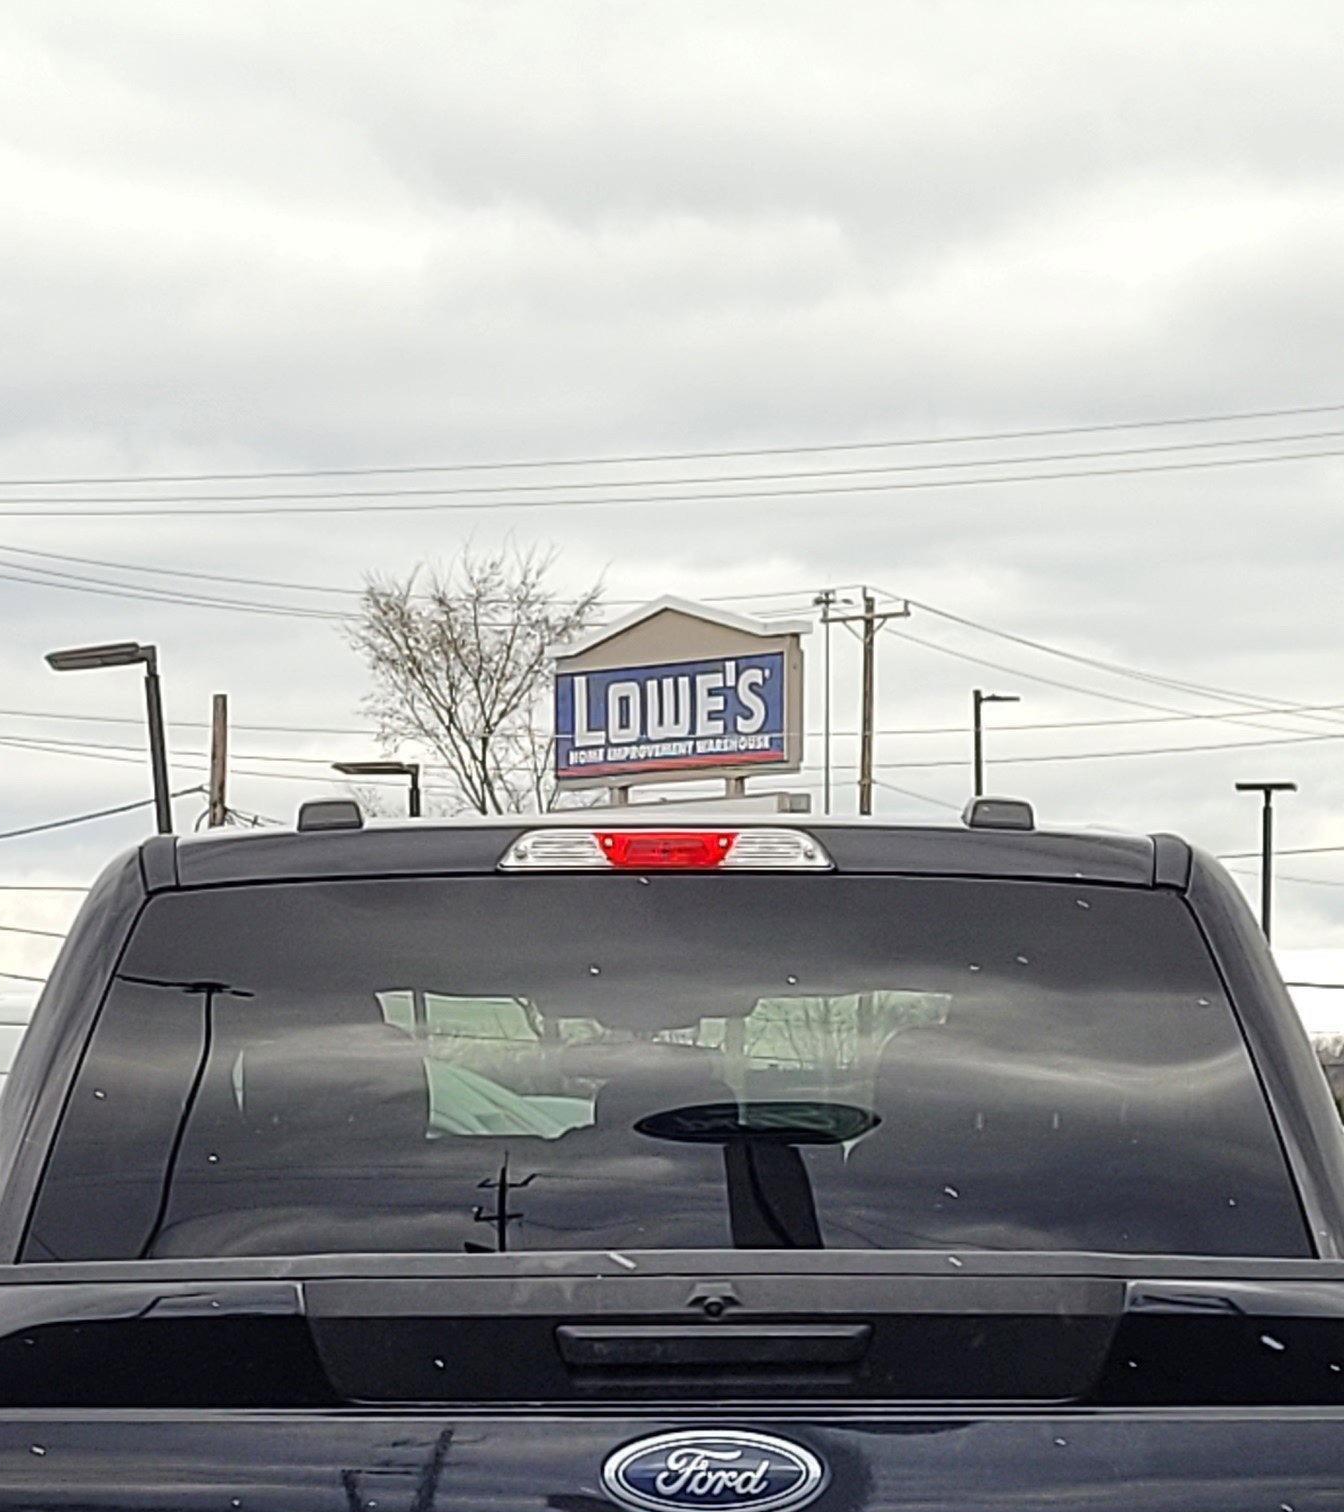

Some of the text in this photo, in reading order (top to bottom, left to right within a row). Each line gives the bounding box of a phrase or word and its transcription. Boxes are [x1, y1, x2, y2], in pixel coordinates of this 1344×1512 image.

[573, 661, 768, 747] LOWE'S
[569, 735, 770, 766] HOME IMPROVEMENT WAREHOUSE
[657, 1448, 769, 1496] Ford
